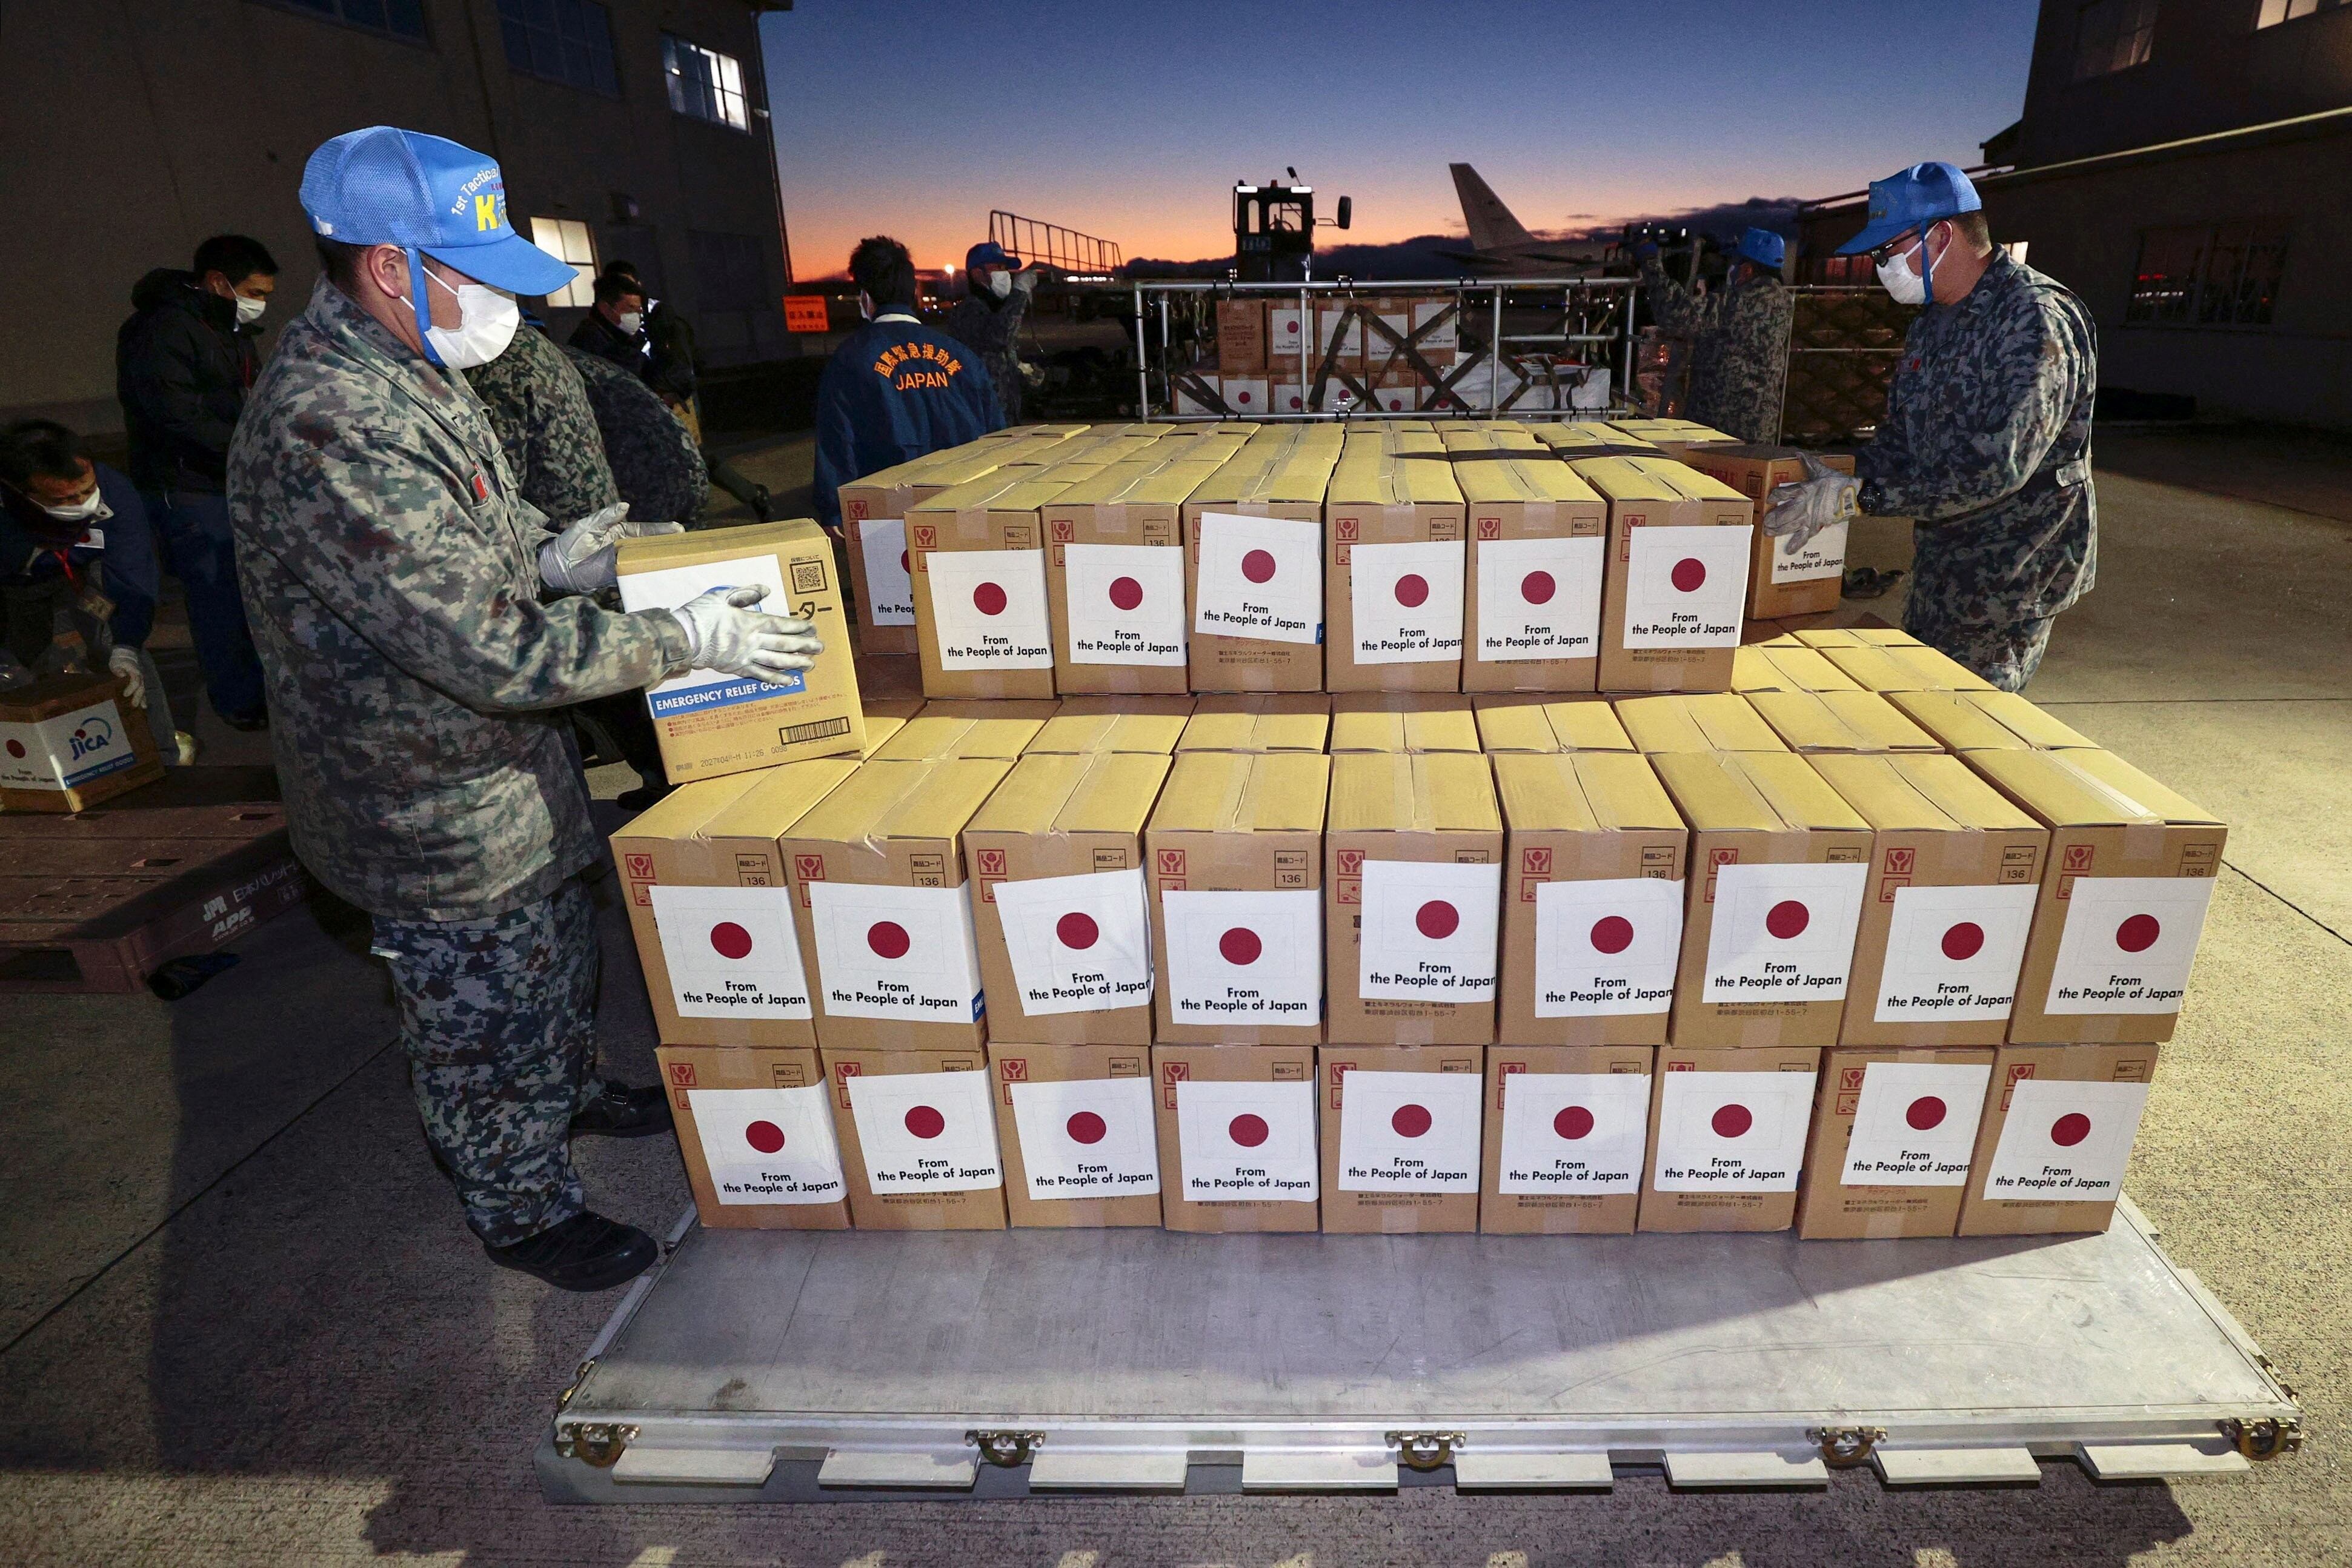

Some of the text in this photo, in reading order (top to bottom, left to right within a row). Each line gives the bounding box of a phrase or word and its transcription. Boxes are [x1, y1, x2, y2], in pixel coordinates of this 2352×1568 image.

[451, 195, 468, 216] 1st
[460, 167, 499, 196] Tactical
[874, 342, 963, 378] 国際緊急援助隊
[895, 371, 948, 391] JAPAN
[1778, 559, 1843, 571] the People of Japan
[878, 604, 892, 613] the
[1243, 602, 1269, 614] From
[1204, 610, 1306, 631] the People of Japan
[1672, 612, 1698, 622] From
[1115, 630, 1140, 640] From
[1400, 628, 1426, 638] From
[1524, 625, 1550, 635] From
[1632, 623, 1735, 637] the People of Japan
[983, 635, 1009, 645] From
[1361, 637, 1463, 653] the People of Japan
[1486, 634, 1589, 649] the People of Japan
[947, 645, 1048, 659] the People of Japan
[1077, 639, 1178, 655] the People of Japan
[656, 689, 723, 711] EMERGENCY
[725, 683, 759, 699] RELIEF
[1281, 874, 1301, 883] 136
[2006, 869, 2025, 879] 136
[2185, 868, 2205, 877] 136
[747, 877, 766, 885] 136
[920, 878, 939, 886] 136
[1419, 962, 1452, 974] From
[1764, 962, 1797, 973] From
[1072, 972, 1105, 984] From
[1370, 972, 1497, 990] the People of Japan
[1594, 977, 1626, 988] From
[1715, 974, 1842, 990] the People of Japan
[2108, 975, 2142, 986] From
[725, 980, 757, 992] From
[877, 980, 909, 992] From
[1029, 988, 1049, 1000] the
[1052, 984, 1095, 1000] People
[1098, 982, 1111, 994] of
[1937, 983, 1970, 994] From
[1227, 987, 1259, 998] From
[1546, 988, 1673, 1004] the People of Japan
[2058, 986, 2184, 1002] the People of Japan
[683, 991, 806, 1008] the People of Japan
[832, 989, 958, 1010] the People of Japan
[1887, 994, 2012, 1009] the People of Japan
[1180, 998, 1307, 1014] the People of Japan
[1900, 1150, 1930, 1160] From
[918, 1158, 949, 1169] From
[1077, 1163, 1108, 1174] From
[1394, 1157, 1424, 1168] From
[1555, 1159, 1586, 1169] From
[1711, 1157, 1742, 1168] From
[1853, 1160, 1872, 1171] the
[1875, 1161, 1916, 1174] People
[1919, 1161, 1933, 1172] of
[761, 1172, 791, 1182] From
[877, 1168, 995, 1182] the People of Japan
[1235, 1167, 1266, 1177] From
[1348, 1166, 1467, 1182] the People of Japan
[1509, 1169, 1629, 1183] the People of Japan
[1664, 1168, 1786, 1181] the People of Japan
[2042, 1166, 2071, 1176] From
[1035, 1172, 1154, 1188] the People of Japan
[1191, 1177, 1311, 1191] the People of Japan
[1995, 1175, 2110, 1191] the People of Japan
[723, 1180, 839, 1195] the People of Japan
